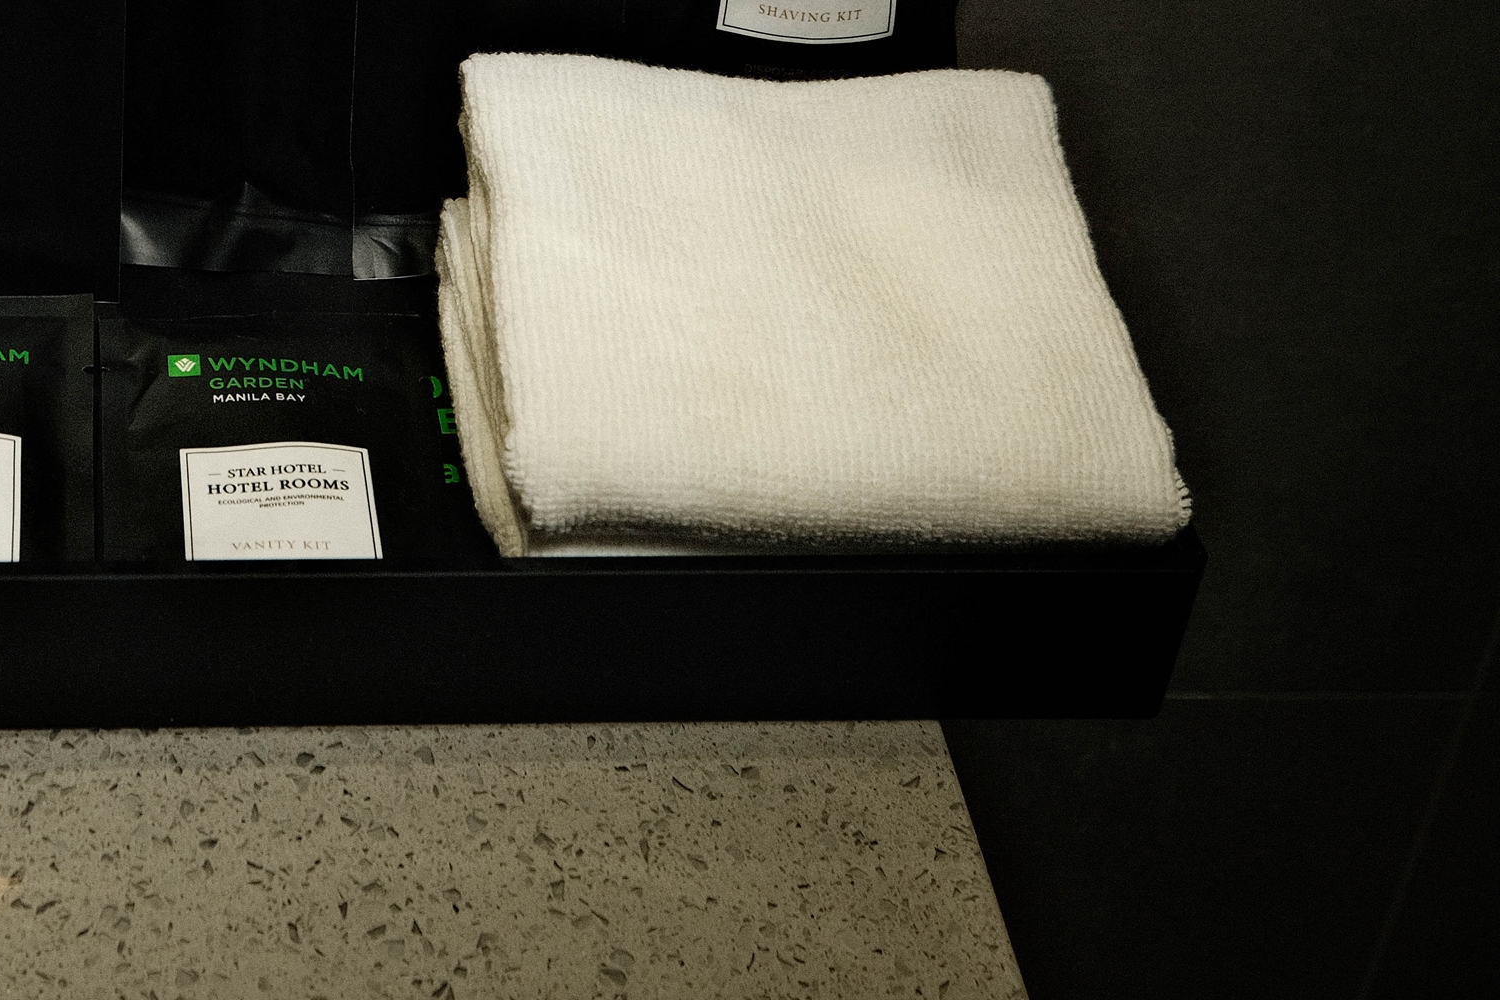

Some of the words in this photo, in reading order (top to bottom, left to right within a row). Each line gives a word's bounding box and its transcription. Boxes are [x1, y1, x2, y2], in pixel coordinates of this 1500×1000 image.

[758, 4, 831, 23] SHAVING
[837, 9, 862, 22] KIT
[208, 357, 363, 382] WYNDHAM
[213, 393, 270, 403] MANILA
[276, 393, 306, 402] BAY
[227, 467, 267, 478] STAR
[271, 464, 327, 476] HOTEL
[208, 482, 274, 495] HOTEL
[280, 478, 349, 491] ROOMS
[232, 540, 296, 551] VANITY
[303, 540, 332, 550] KIT
